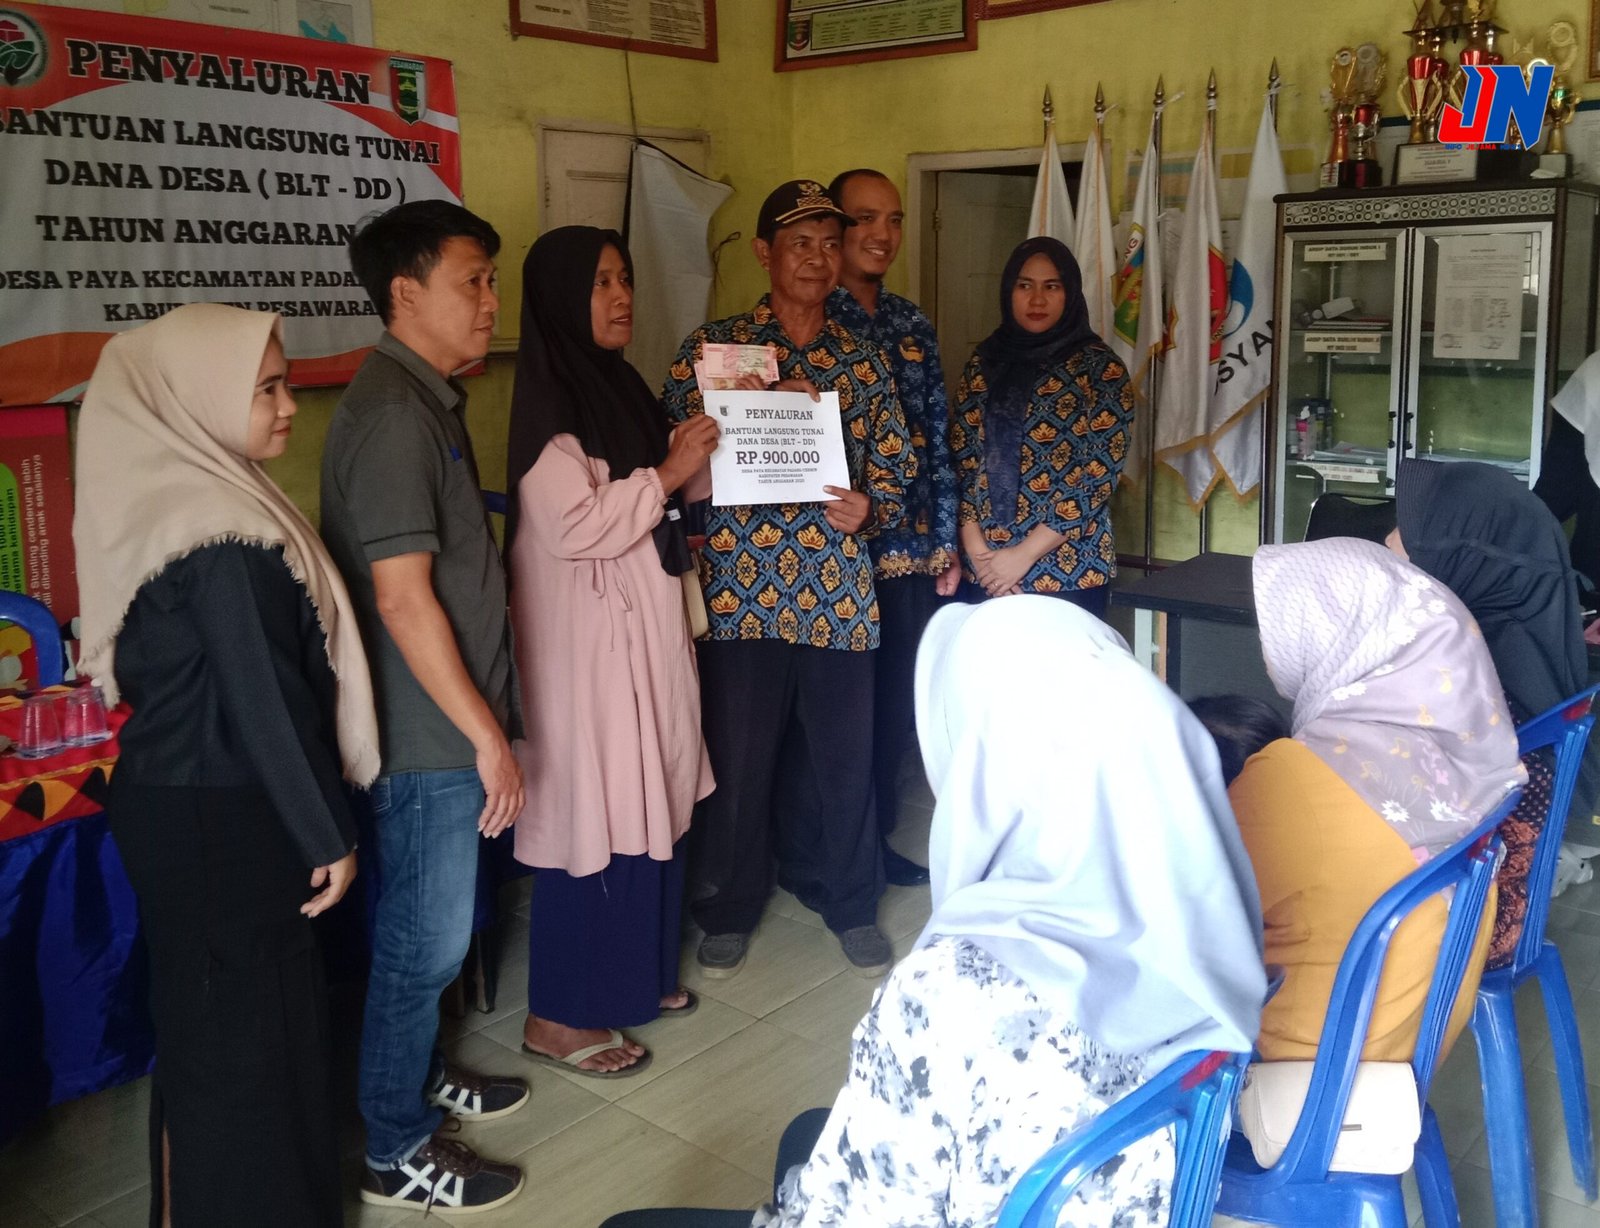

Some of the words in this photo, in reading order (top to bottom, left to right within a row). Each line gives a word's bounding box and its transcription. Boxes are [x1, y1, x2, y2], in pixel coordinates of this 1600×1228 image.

[65, 38, 371, 105] PENYALURAN
[0, 107, 165, 143] ANTUAN
[174, 120, 350, 157] LANGSUNG
[355, 136, 440, 164] TUNAI
[44, 159, 152, 189] DANA
[159, 166, 250, 193] DESA
[275, 172, 330, 197] BLT
[353, 176, 392, 200] DD
[35, 215, 164, 243] TAHUN
[174, 219, 356, 246] ANGGARAN
[67, 270, 139, 289] PAYA
[142, 270, 295, 288] KECAMATAN
[301, 271, 366, 287] PADA
[257, 300, 383, 317] PESAWARA
[725, 427, 762, 435] BANTUAN
[745, 409, 813, 420] PENYALURAN
[21, 458, 31, 485] lebih
[735, 450, 820, 465] RP.900.000
[32, 454, 44, 508] seusianya
[6, 488, 18, 548] kehidupan
[23, 486, 36, 543] cenderung
[36, 510, 47, 536] anak
[1, 554, 10, 589] dalam
[29, 545, 40, 589] Stunting
[37, 538, 51, 590] dibanding
